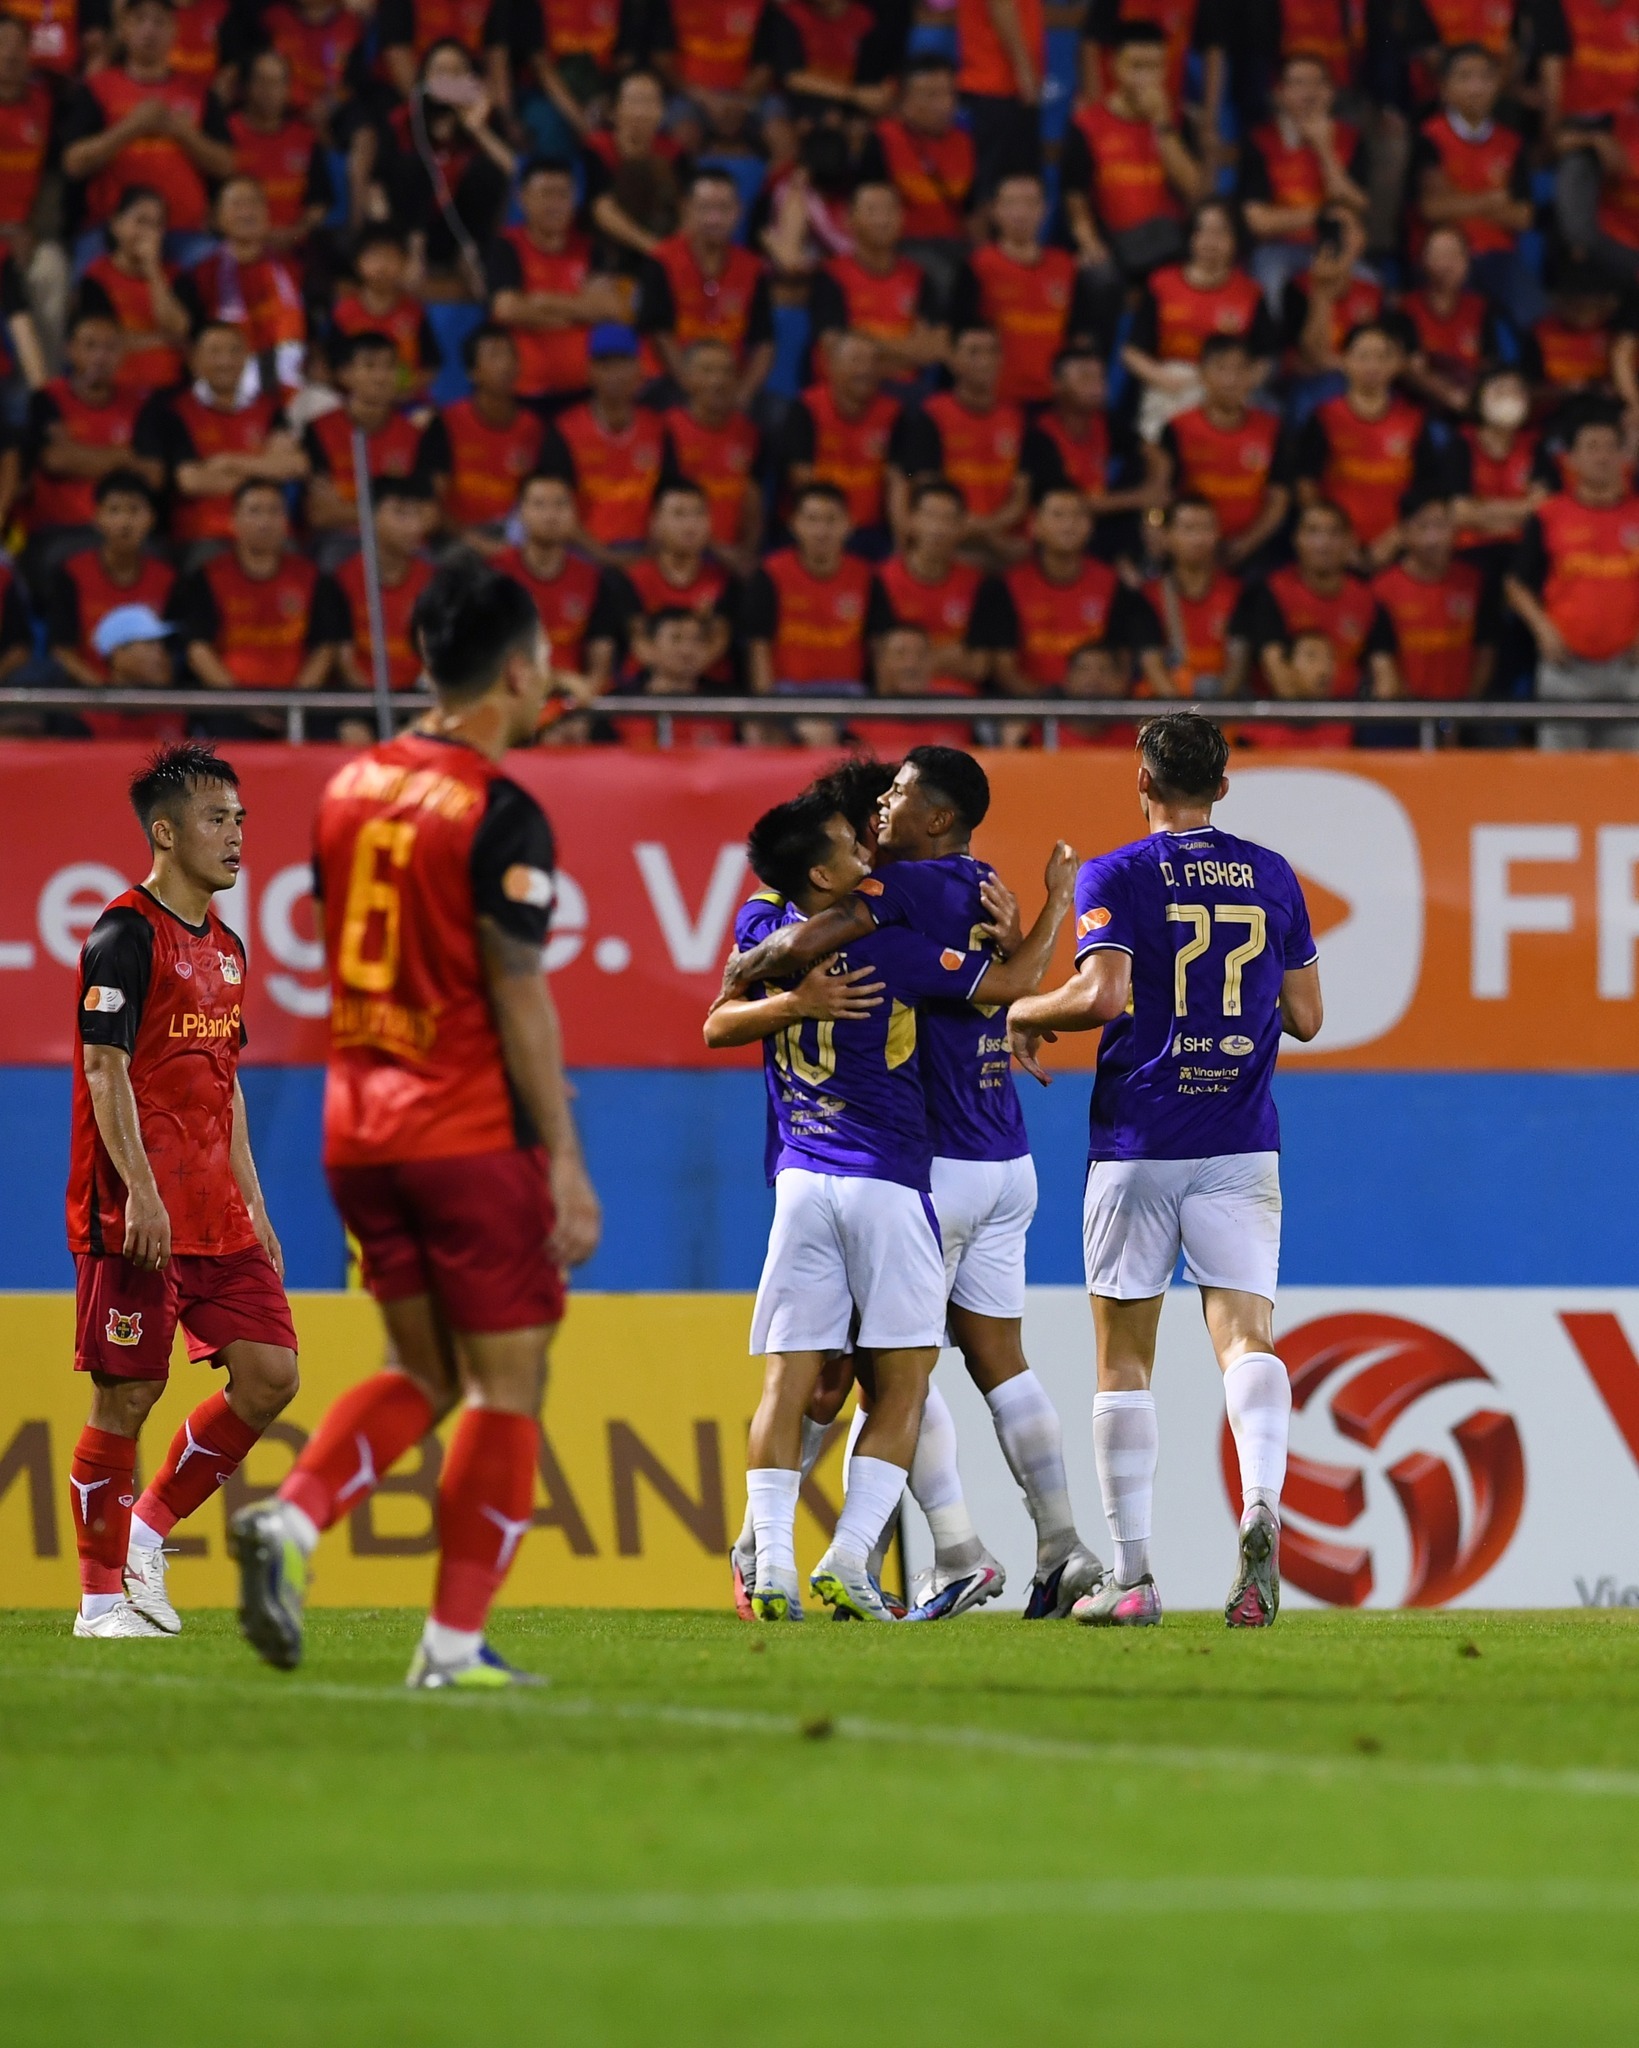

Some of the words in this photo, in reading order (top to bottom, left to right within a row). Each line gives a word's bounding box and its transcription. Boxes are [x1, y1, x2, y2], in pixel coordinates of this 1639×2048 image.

[1159, 861, 1180, 887] D.
[1183, 860, 1254, 888] FISHER
[339, 818, 416, 991] 6
[1165, 903, 1266, 1017] 77
[168, 1013, 232, 1038] LPBank
[1183, 1037, 1214, 1053] SHS
